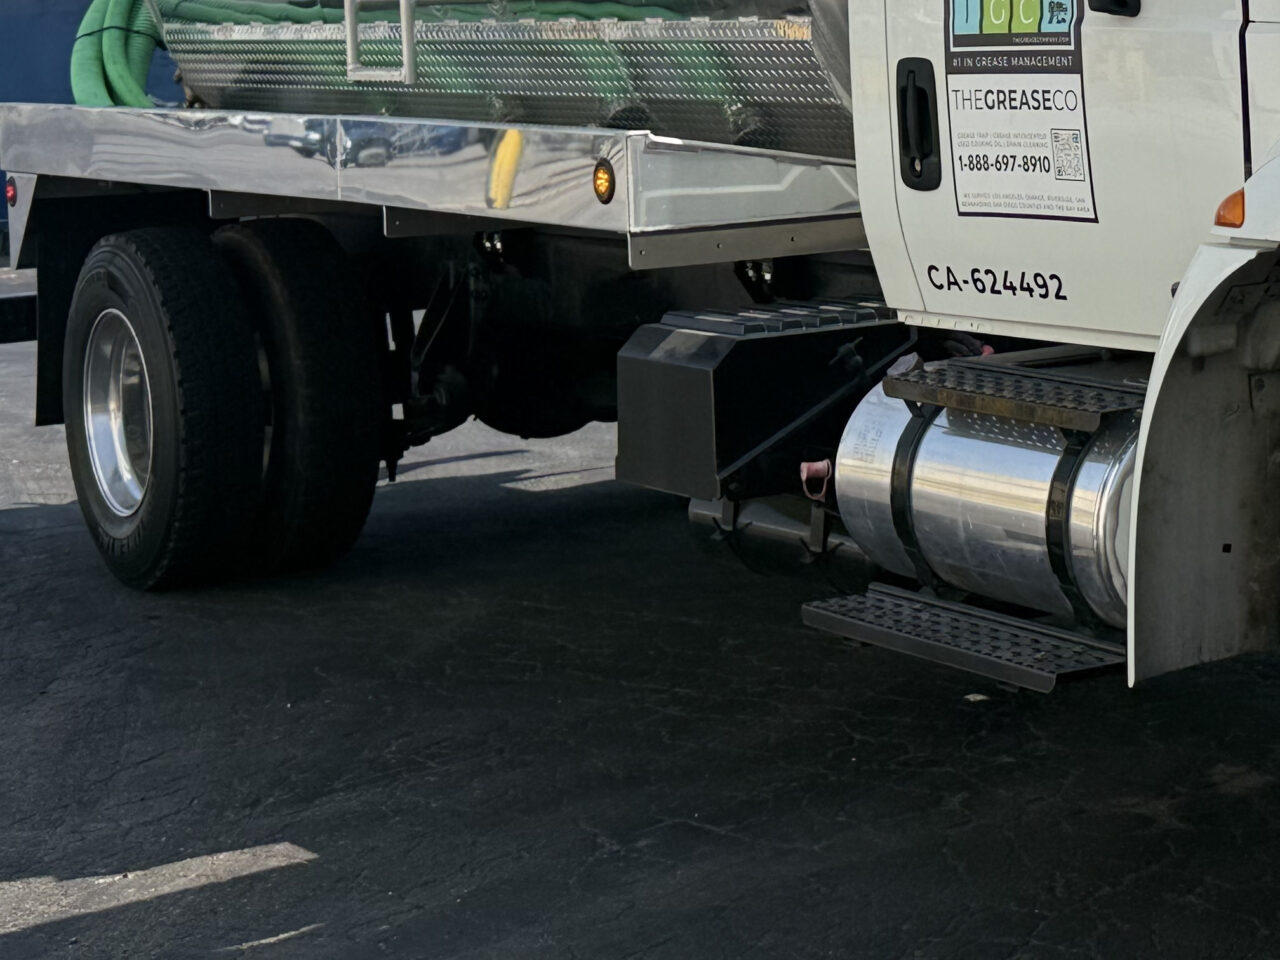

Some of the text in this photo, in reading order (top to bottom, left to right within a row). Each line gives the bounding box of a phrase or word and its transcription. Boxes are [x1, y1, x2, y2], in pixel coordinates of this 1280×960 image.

[963, 57, 973, 67] IN
[975, 56, 1009, 67] GREASE
[1011, 55, 1073, 67] MANAGEMENT
[958, 154, 1051, 173] 1-888-697-8910
[927, 264, 1068, 300] CA-624492
